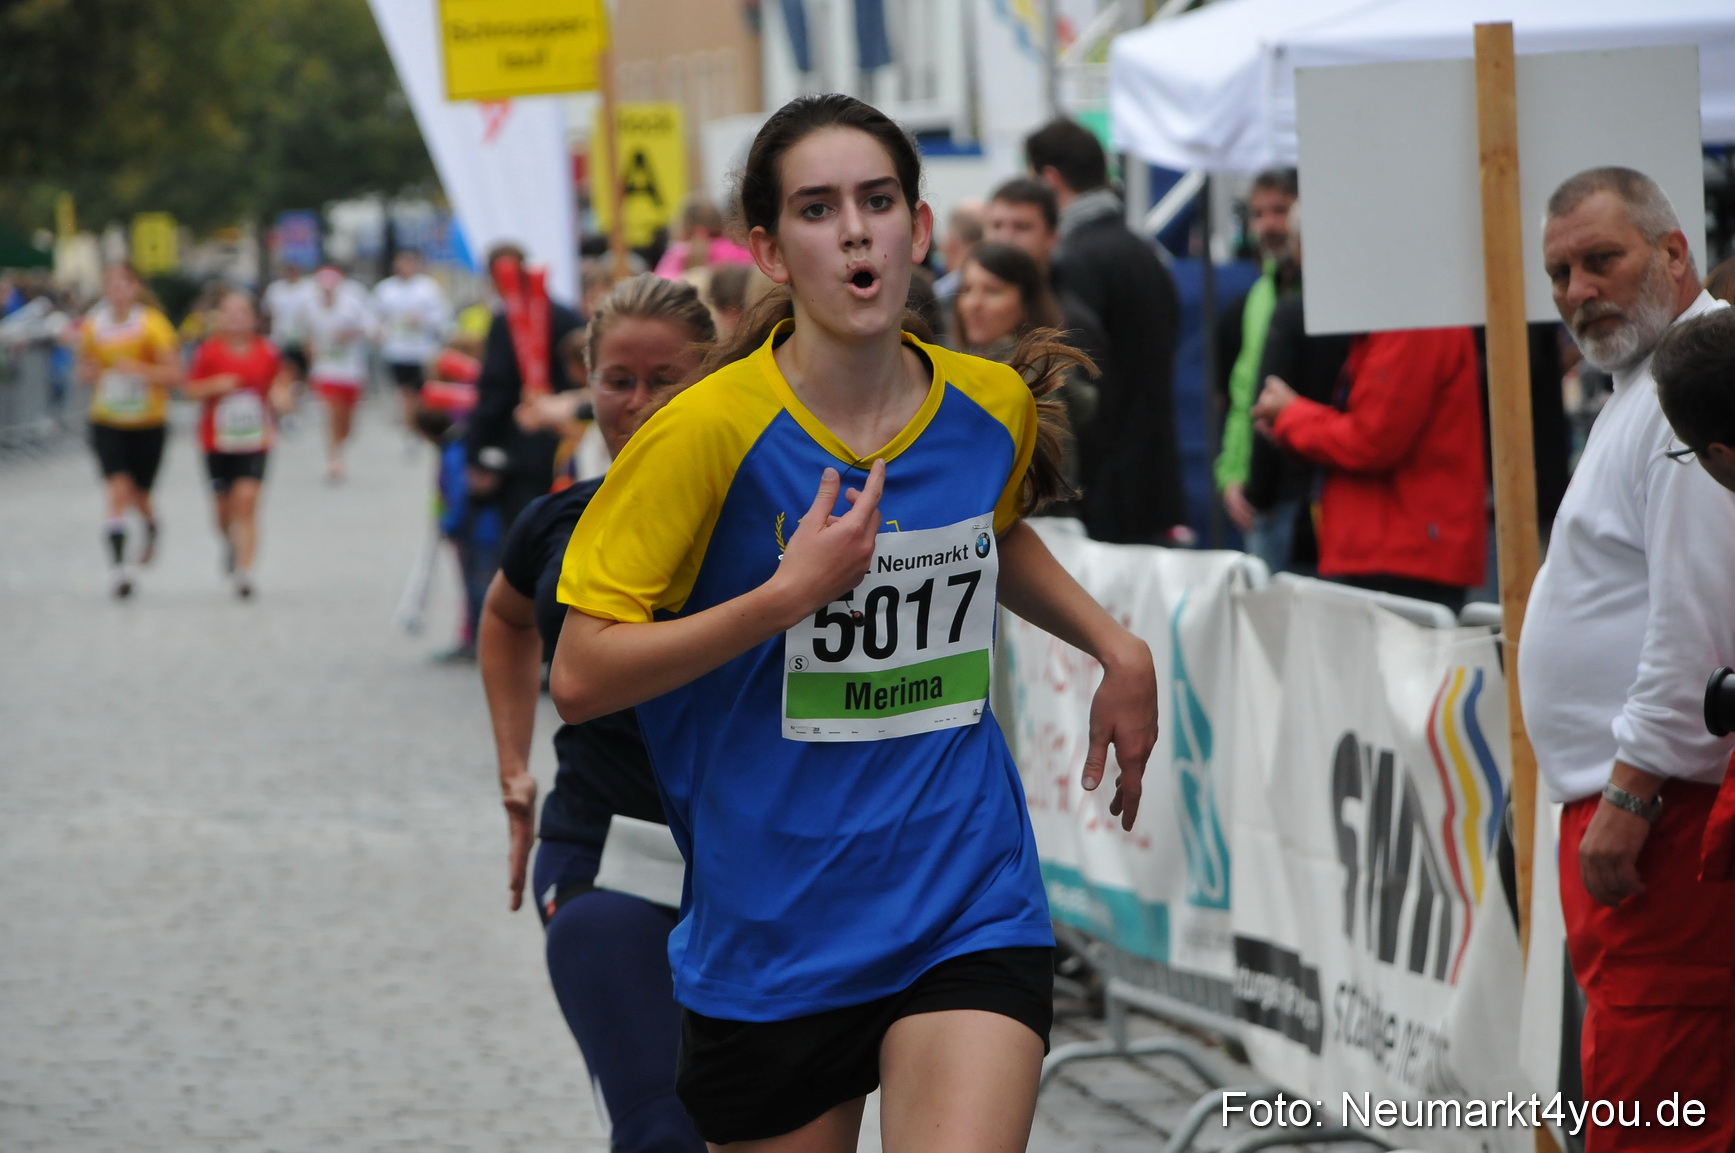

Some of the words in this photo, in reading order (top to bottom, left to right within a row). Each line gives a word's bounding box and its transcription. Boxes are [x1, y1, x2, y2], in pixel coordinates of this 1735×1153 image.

[616, 148, 664, 207] A
[877, 544, 969, 574] Neumarkt
[812, 569, 982, 663] 5017
[794, 657, 803, 670] S
[844, 675, 943, 711] Merima
